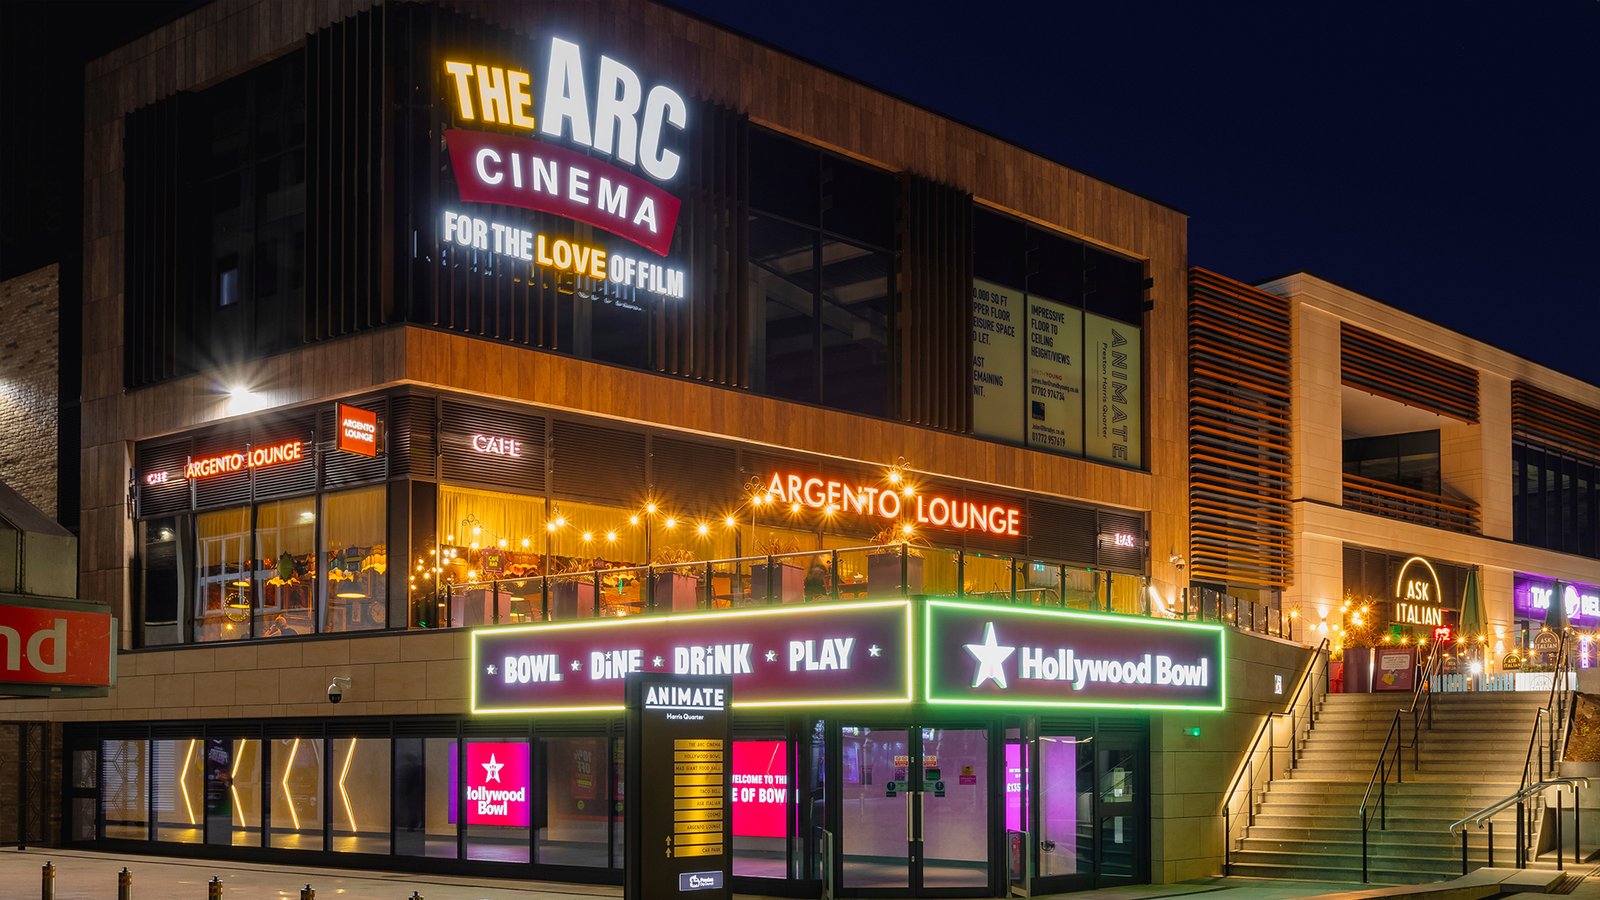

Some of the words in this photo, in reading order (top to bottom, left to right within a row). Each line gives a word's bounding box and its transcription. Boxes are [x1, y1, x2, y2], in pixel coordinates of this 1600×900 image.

[446, 60, 535, 129] THE
[541, 36, 687, 181] ARC
[475, 148, 658, 233] CINEMA
[444, 210, 488, 250] FOR
[491, 222, 533, 261] THE
[537, 234, 606, 279] LOVE
[610, 254, 636, 285] OF
[636, 260, 684, 298] FILM
[991, 292, 999, 304] SQ
[1001, 295, 1008, 307] FT
[991, 306, 1010, 321] FLOOR
[1031, 303, 1065, 324] IMPRESSIVE
[996, 322, 1015, 337] SPACE
[1031, 318, 1050, 334] FLOOR
[1051, 323, 1058, 336] TO
[979, 332, 991, 345] LET.
[1031, 332, 1053, 348] CEILING
[973, 370, 1003, 387] EMAINING
[1112, 328, 1128, 460] ANIMATE
[343, 418, 375, 433] ARGENTO
[345, 428, 374, 443] LOUNGE
[472, 433, 521, 457] CAFE
[186, 454, 244, 479] ARGENTO
[248, 441, 302, 467] LOUNGE
[767, 472, 901, 519] ARGENTO
[917, 494, 1020, 535] LOUNGE
[1407, 580, 1429, 601] ASK
[1397, 603, 1441, 626] ITALIAN
[504, 653, 560, 684] BOWL
[788, 637, 855, 672] PLAY
[1021, 646, 1151, 690] Hollywood
[1155, 655, 1208, 687] Bowl
[645, 686, 724, 706] ANIMATE
[666, 712, 683, 720] Harris
[683, 712, 704, 721] Quarter
[764, 775, 773, 784] TO
[741, 788, 756, 802] OF
[478, 800, 508, 816] Bowl
